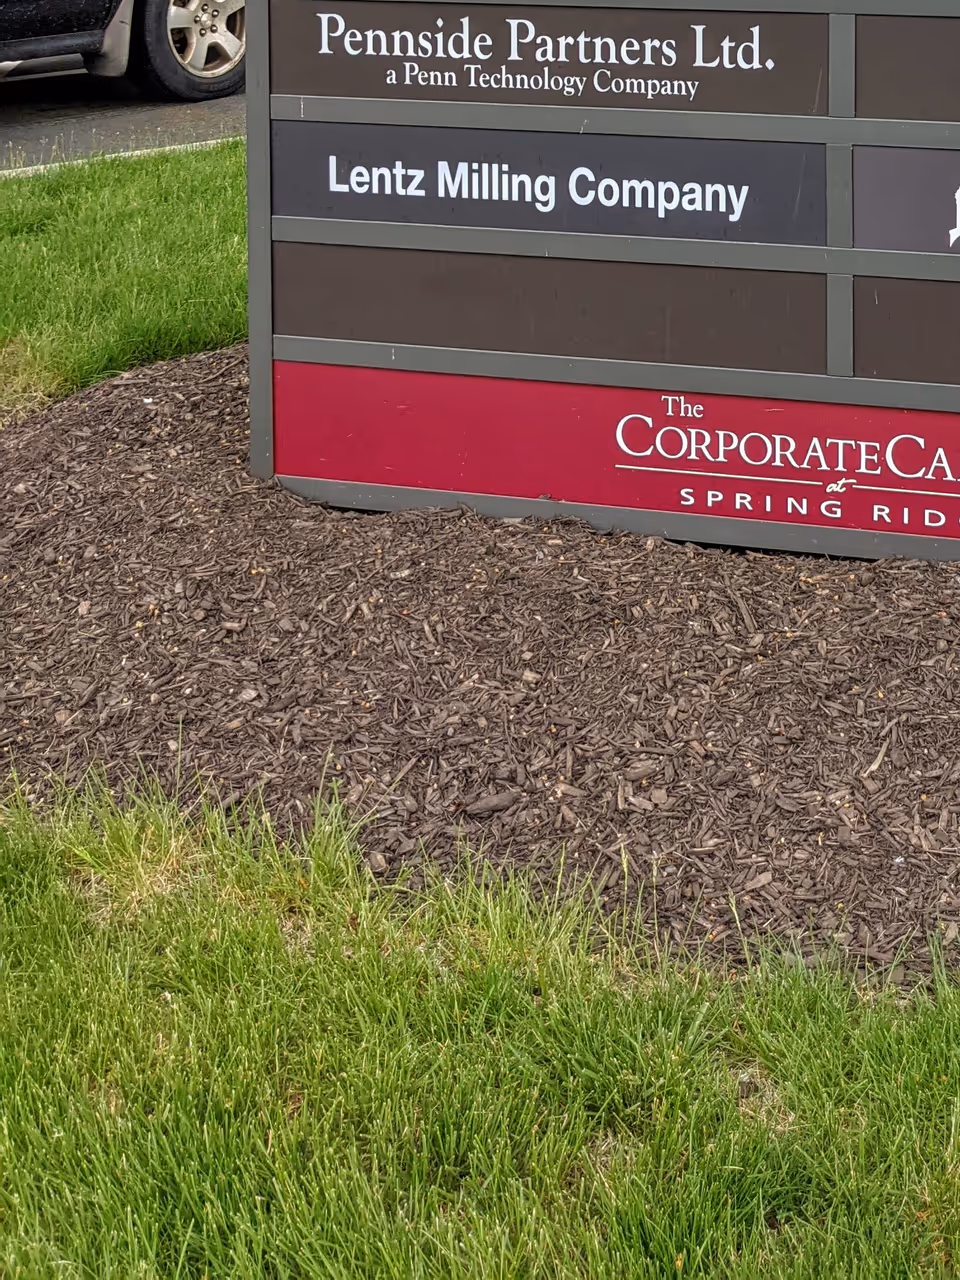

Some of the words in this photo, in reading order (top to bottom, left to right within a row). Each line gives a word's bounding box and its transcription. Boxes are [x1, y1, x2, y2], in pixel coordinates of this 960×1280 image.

[315, 12, 493, 60] Pennside
[505, 18, 677, 67] Partners
[690, 24, 776, 71] Ltd.
[385, 69, 398, 85] a
[402, 61, 458, 87] Penn
[463, 64, 588, 97] Technology
[592, 68, 700, 102] Company
[328, 154, 426, 197] Lentz
[437, 160, 556, 213] Milling
[568, 166, 750, 223] Company
[660, 394, 704, 418] The
[680, 487, 842, 518] SPRING
[825, 477, 858, 493] at
